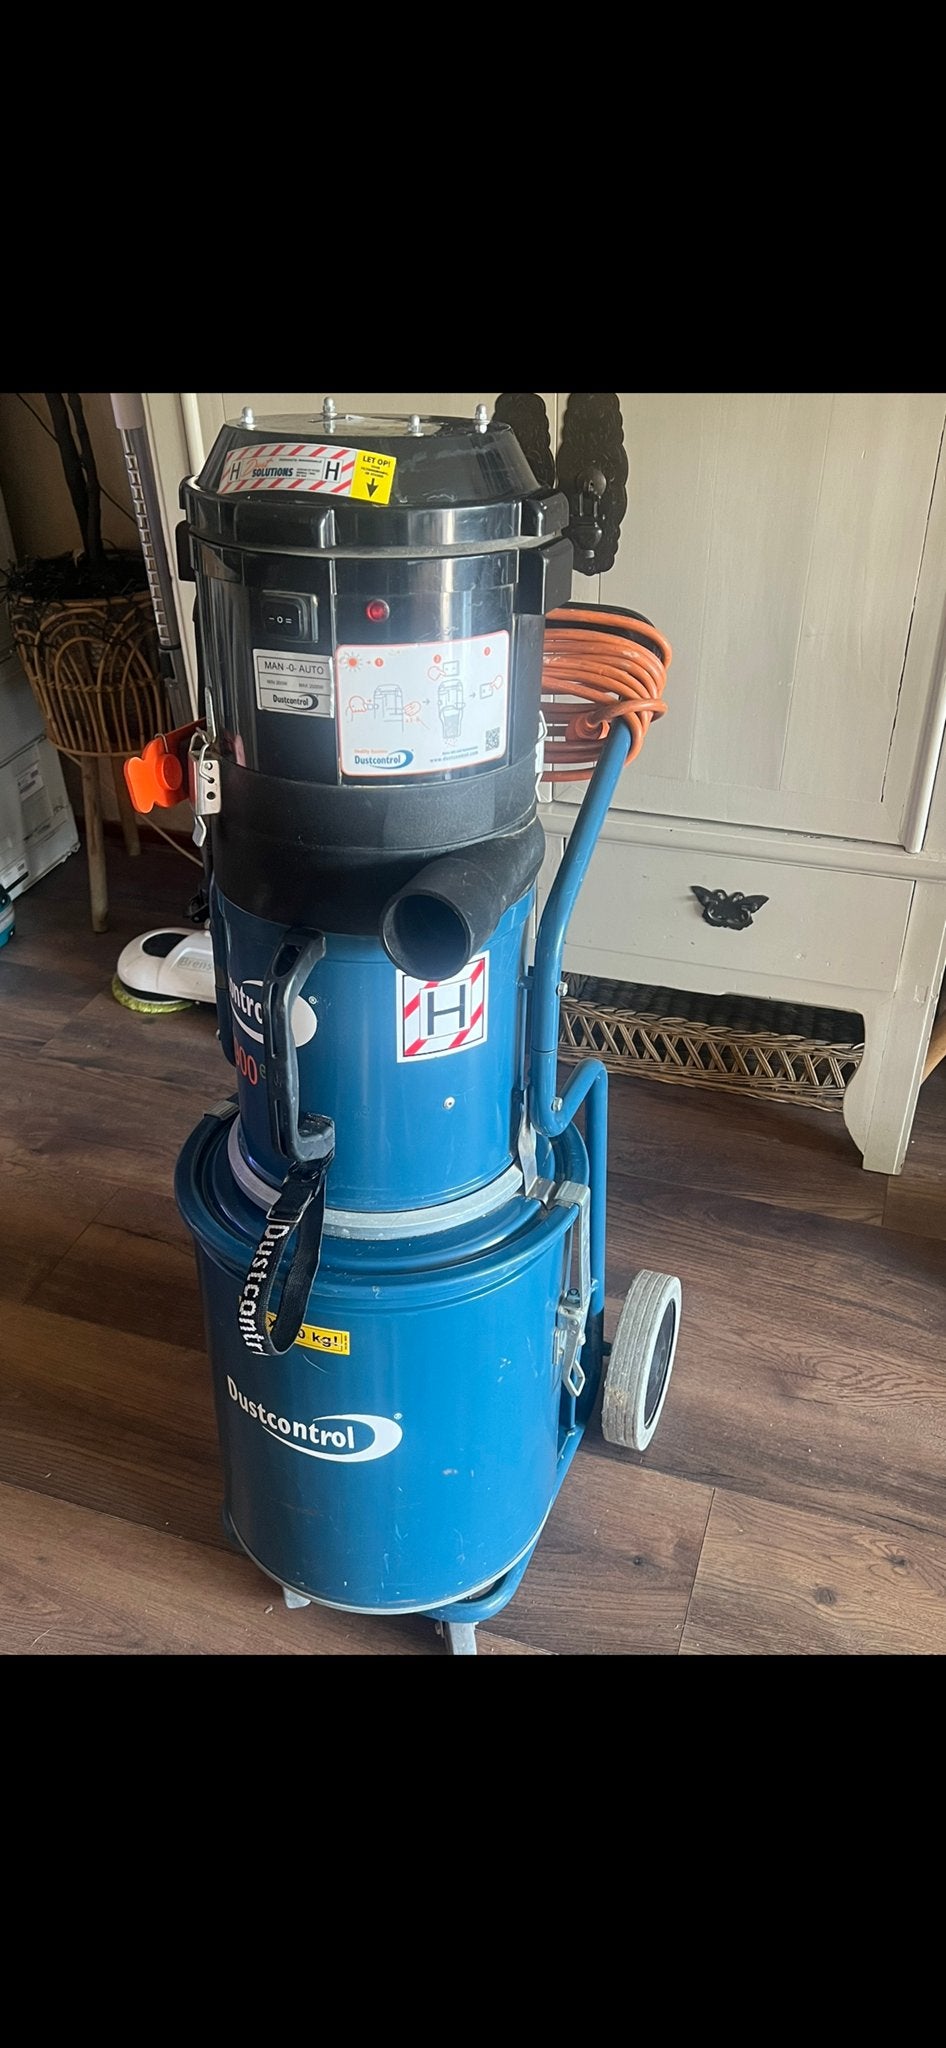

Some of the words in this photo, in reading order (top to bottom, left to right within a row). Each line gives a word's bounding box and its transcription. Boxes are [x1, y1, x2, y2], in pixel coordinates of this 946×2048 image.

[362, 455, 376, 464] LET
[377, 458, 391, 468] OP!
[229, 461, 241, 480] H
[251, 467, 294, 478] SOLUTIONS
[324, 461, 340, 481] H
[264, 661, 284, 671] MAN
[299, 665, 324, 675] AUTO
[272, 694, 309, 706] Dustcontrol
[354, 755, 401, 765] Dustcontrol
[427, 984, 466, 1036] H
[239, 1224, 290, 1356] Dustcontr
[312, 1332, 338, 1348] kg!
[226, 1374, 355, 1449] Dustcontrol
